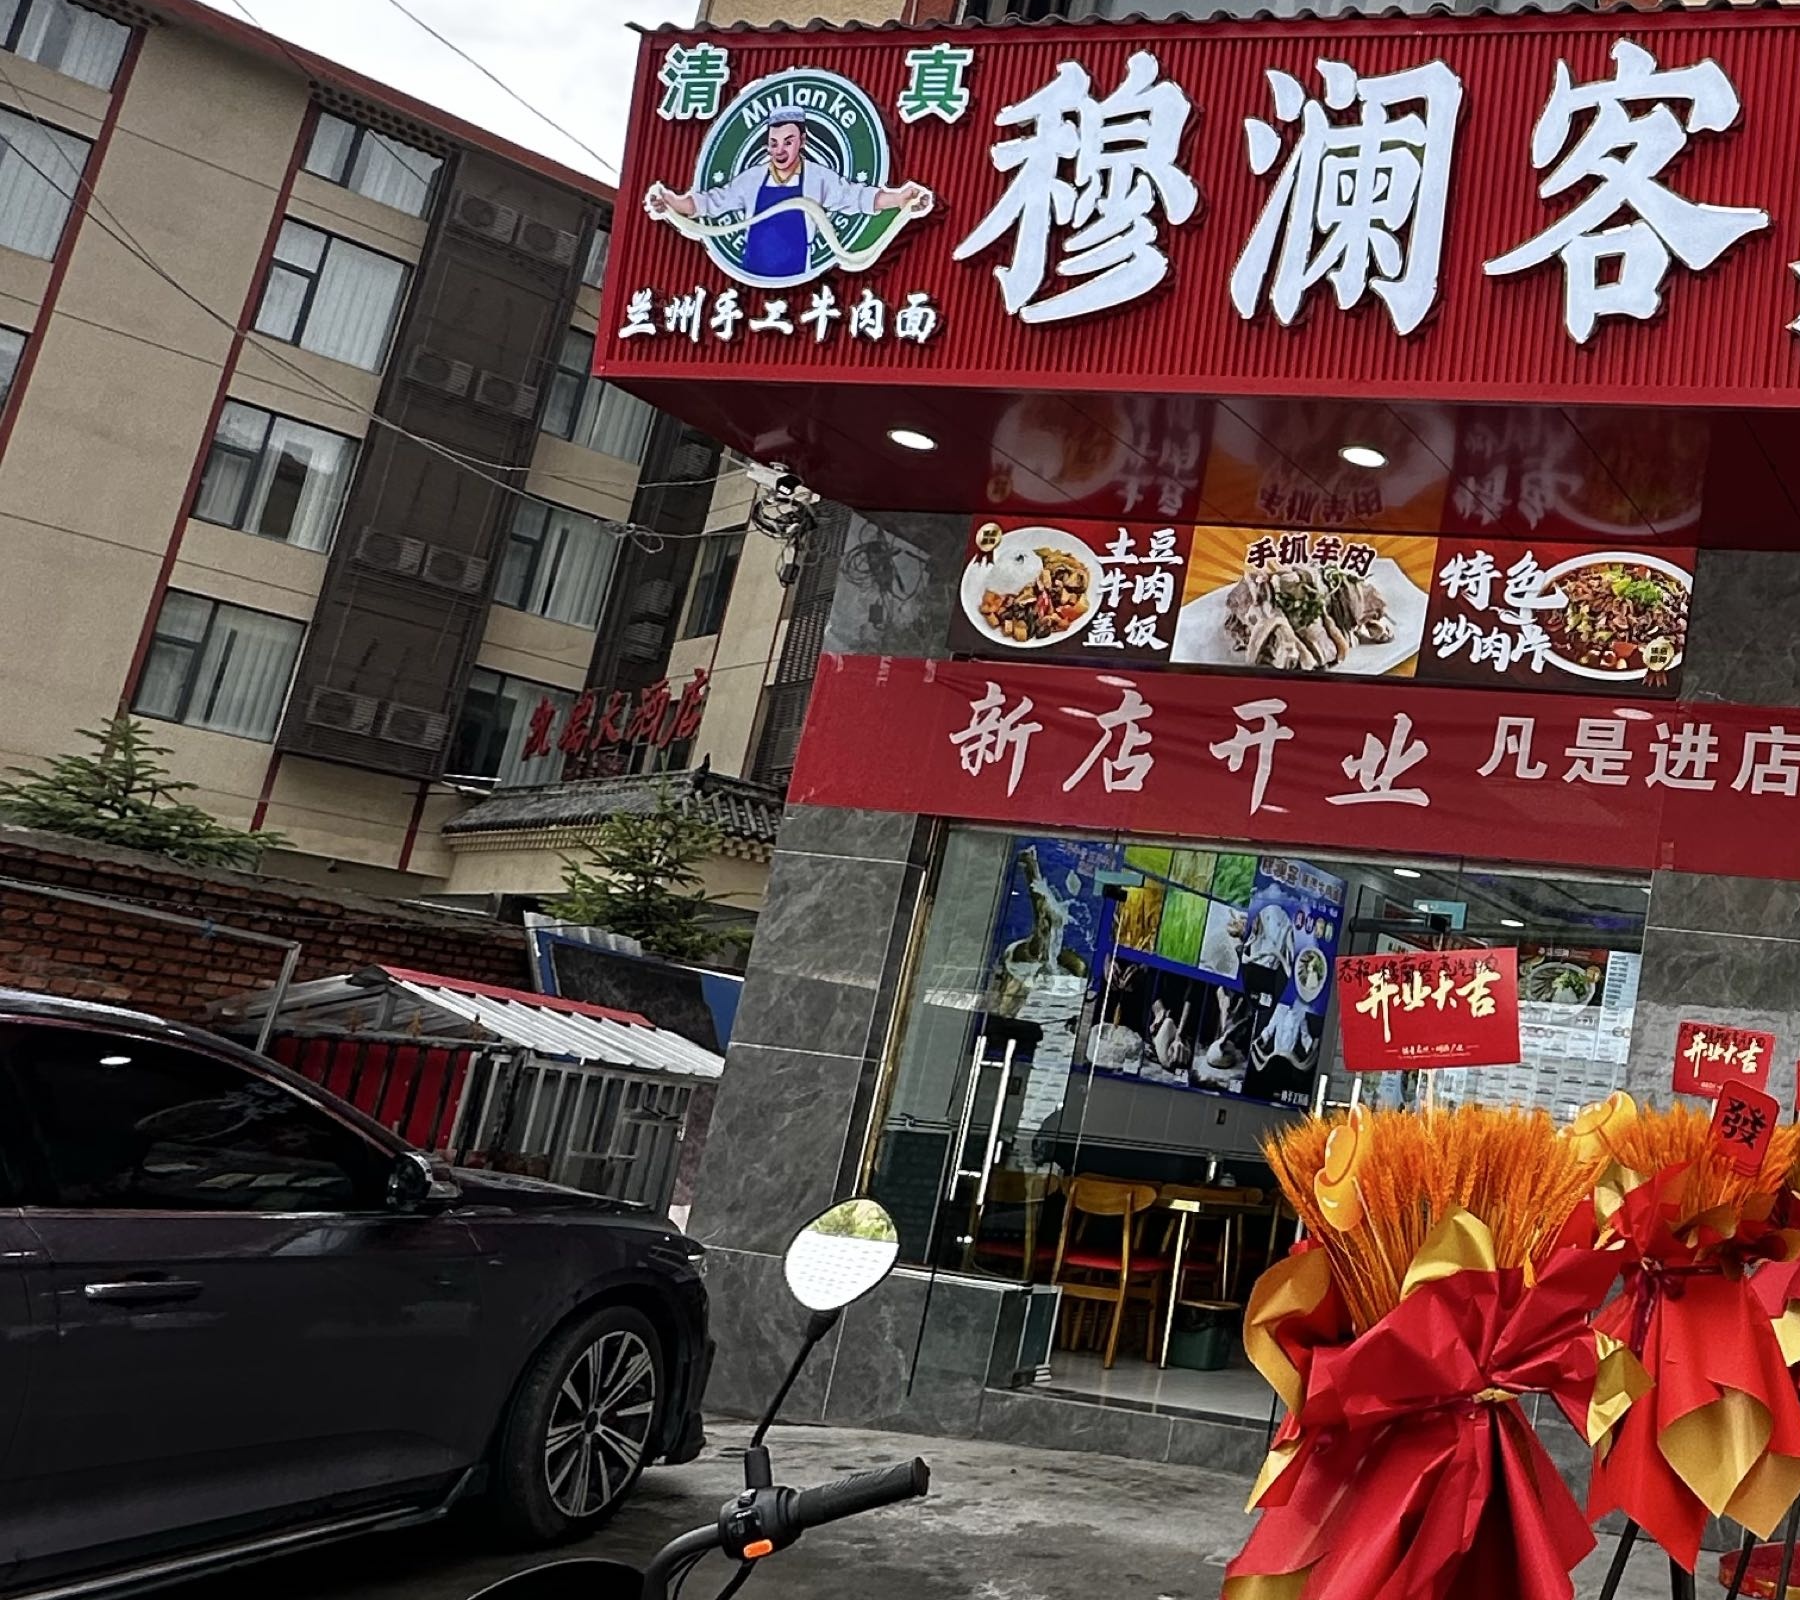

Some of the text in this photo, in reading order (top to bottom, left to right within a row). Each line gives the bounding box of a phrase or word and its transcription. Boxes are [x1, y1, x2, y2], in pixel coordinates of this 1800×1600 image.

[618, 287, 937, 344] 兰州手工牛肉面
[1098, 526, 1184, 565] 土豆
[1246, 533, 1376, 577] 手抓羊肉
[1098, 565, 1175, 614] 牛肉
[1439, 550, 1570, 611] 特色
[1082, 611, 1169, 649] 盖饭
[1432, 612, 1552, 673] 炒肉片
[949, 681, 1432, 816] 新店开业
[1355, 960, 1502, 1043] 开业大吉
[1683, 1031, 1764, 1078] 开业大吉
